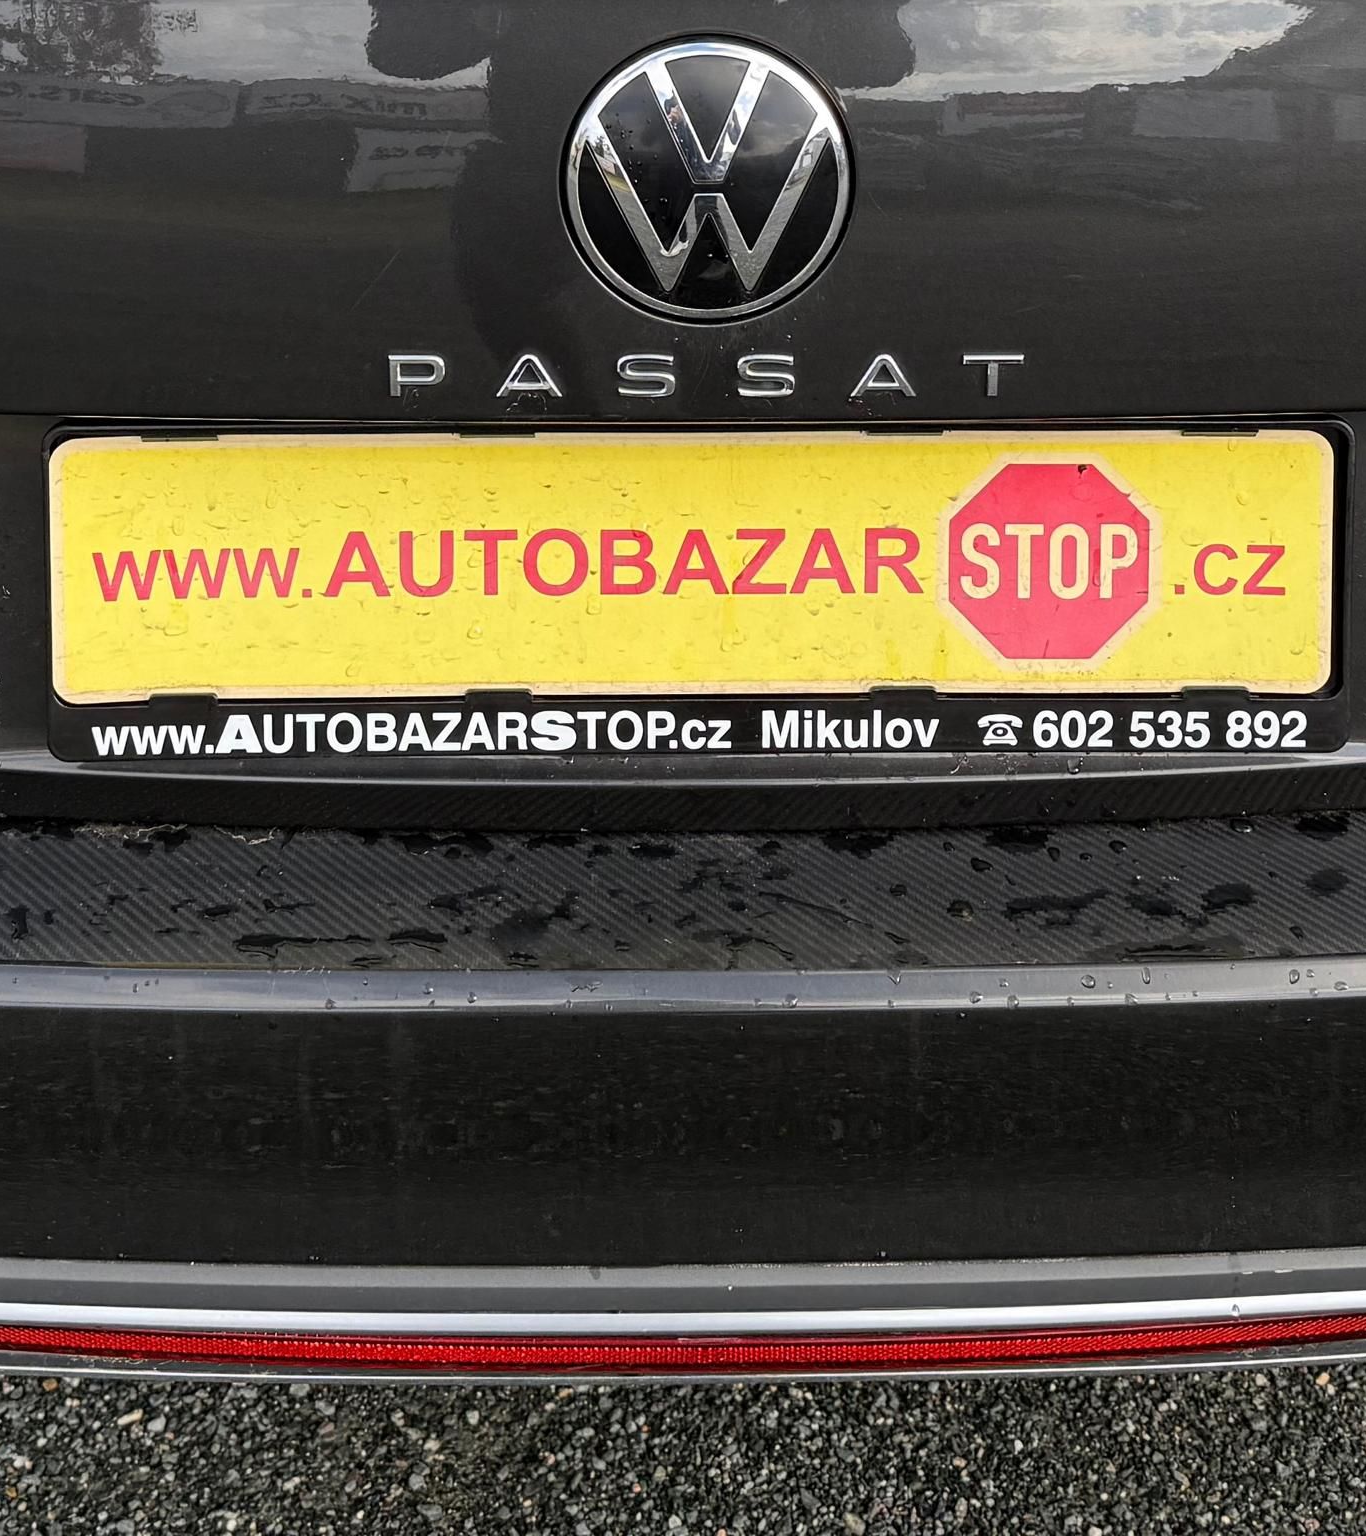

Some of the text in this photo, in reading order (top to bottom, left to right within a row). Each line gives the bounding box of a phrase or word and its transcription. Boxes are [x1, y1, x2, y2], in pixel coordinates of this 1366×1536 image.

[387, 352, 1026, 398] PASSAT
[960, 522, 1139, 600] STOP
[91, 709, 1308, 756] www.AUTOBAZARSTOP.cz Mikulov 602 535 892
